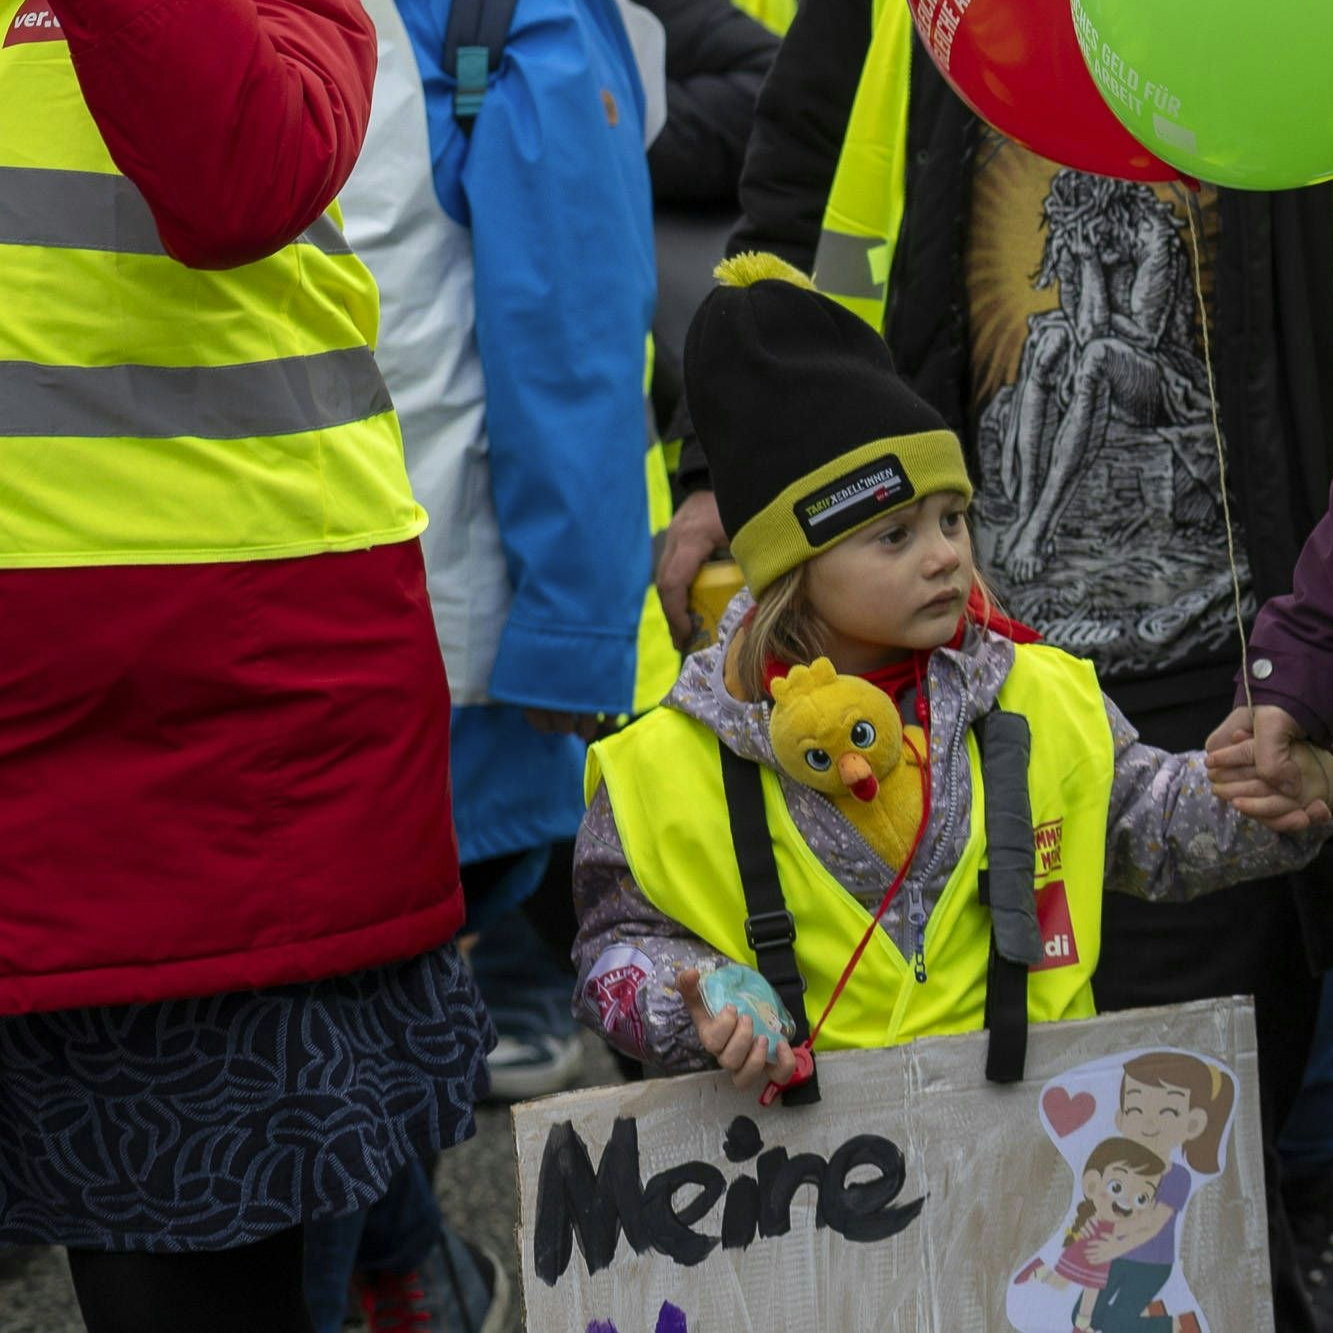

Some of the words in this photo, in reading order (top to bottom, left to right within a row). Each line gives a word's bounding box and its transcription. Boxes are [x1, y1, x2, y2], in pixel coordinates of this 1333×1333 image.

[1094, 57, 1143, 117] ARBEIT
[1102, 42, 1139, 92] GELD
[1143, 80, 1182, 119] FÜR
[534, 1115, 930, 1287] Meine
